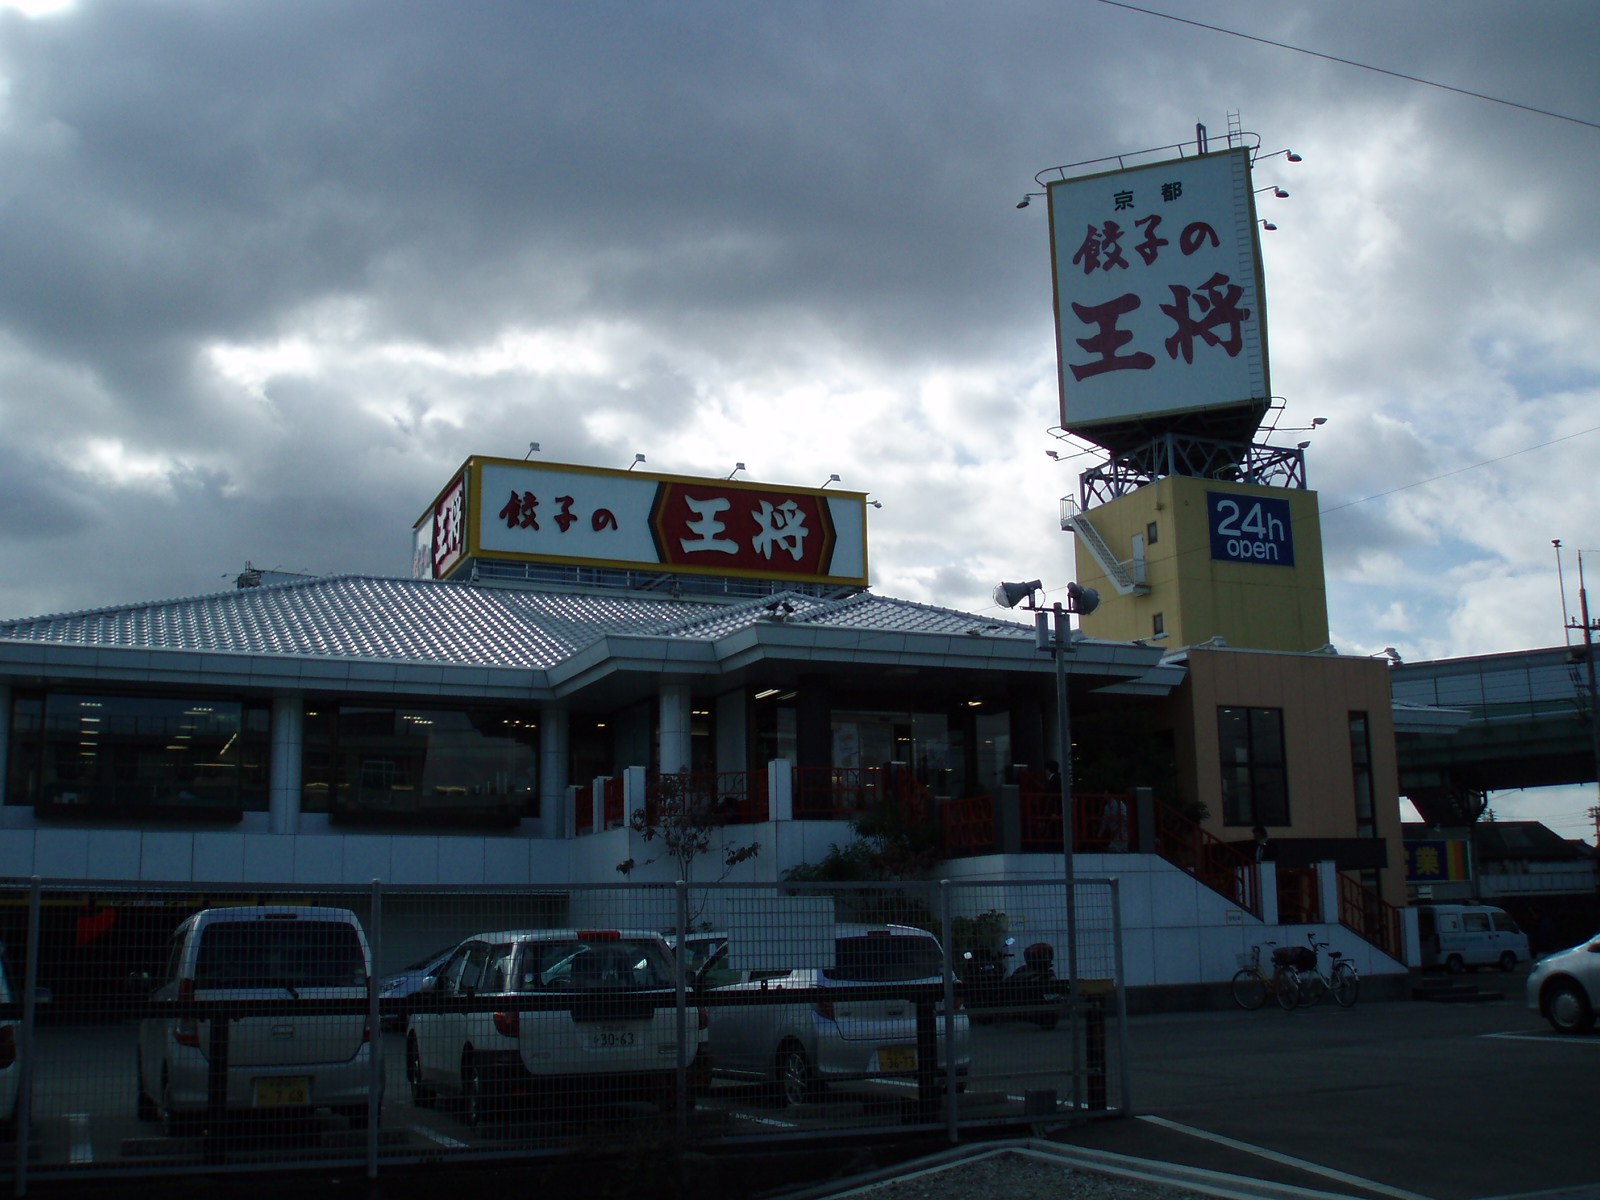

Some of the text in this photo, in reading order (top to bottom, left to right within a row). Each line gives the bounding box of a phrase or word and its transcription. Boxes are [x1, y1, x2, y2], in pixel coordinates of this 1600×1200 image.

[1113, 181, 1182, 211] 京都
[1072, 214, 1220, 275] 餃子の
[1068, 272, 1250, 382] 王将
[435, 487, 462, 565] 王将
[499, 490, 809, 561] 餃子の 王将
[1216, 499, 1284, 541] 24h
[1226, 539, 1279, 560] open
